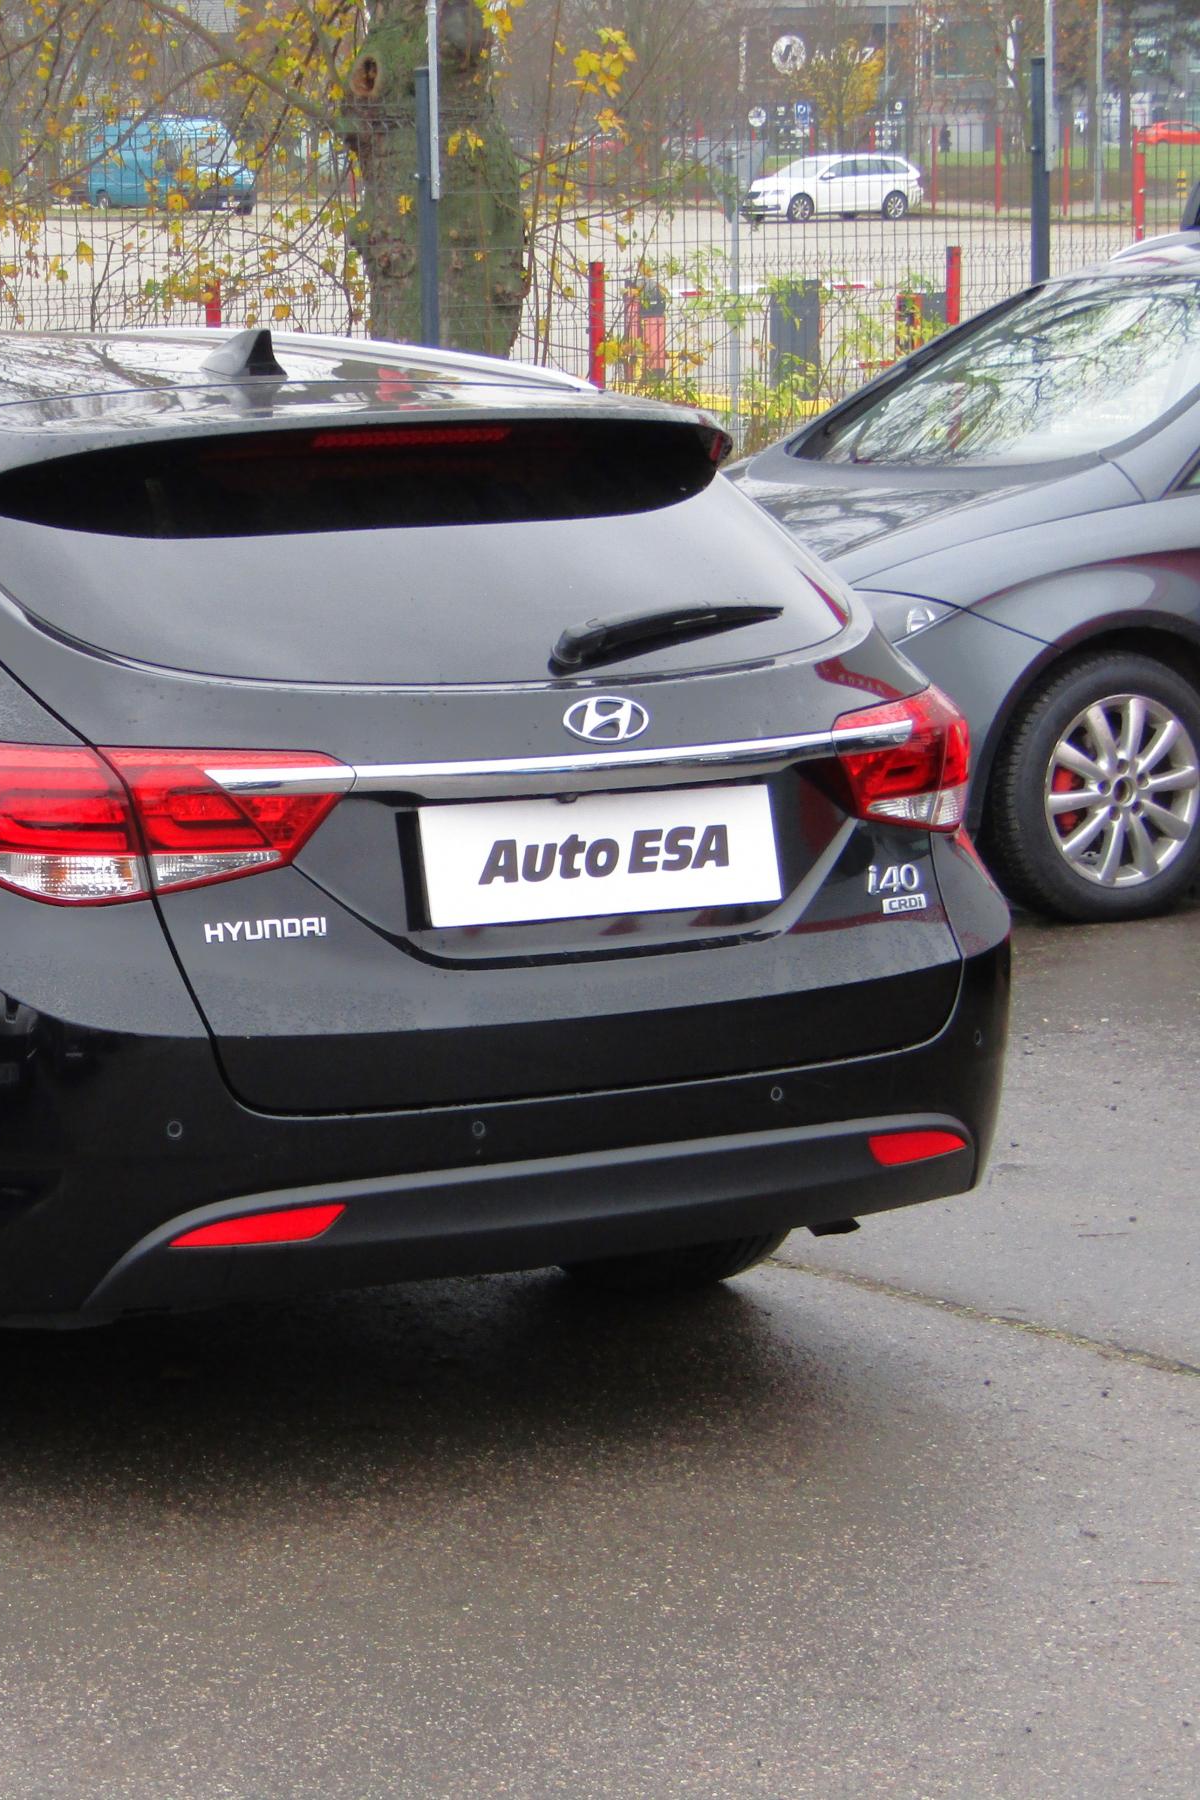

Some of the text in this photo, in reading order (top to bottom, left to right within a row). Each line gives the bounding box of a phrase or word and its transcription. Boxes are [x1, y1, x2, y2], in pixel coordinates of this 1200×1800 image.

[478, 824, 730, 885] Auto ESA
[867, 864, 920, 895] i40
[888, 896, 923, 911] CRDi
[203, 916, 327, 943] HYUNDAI
